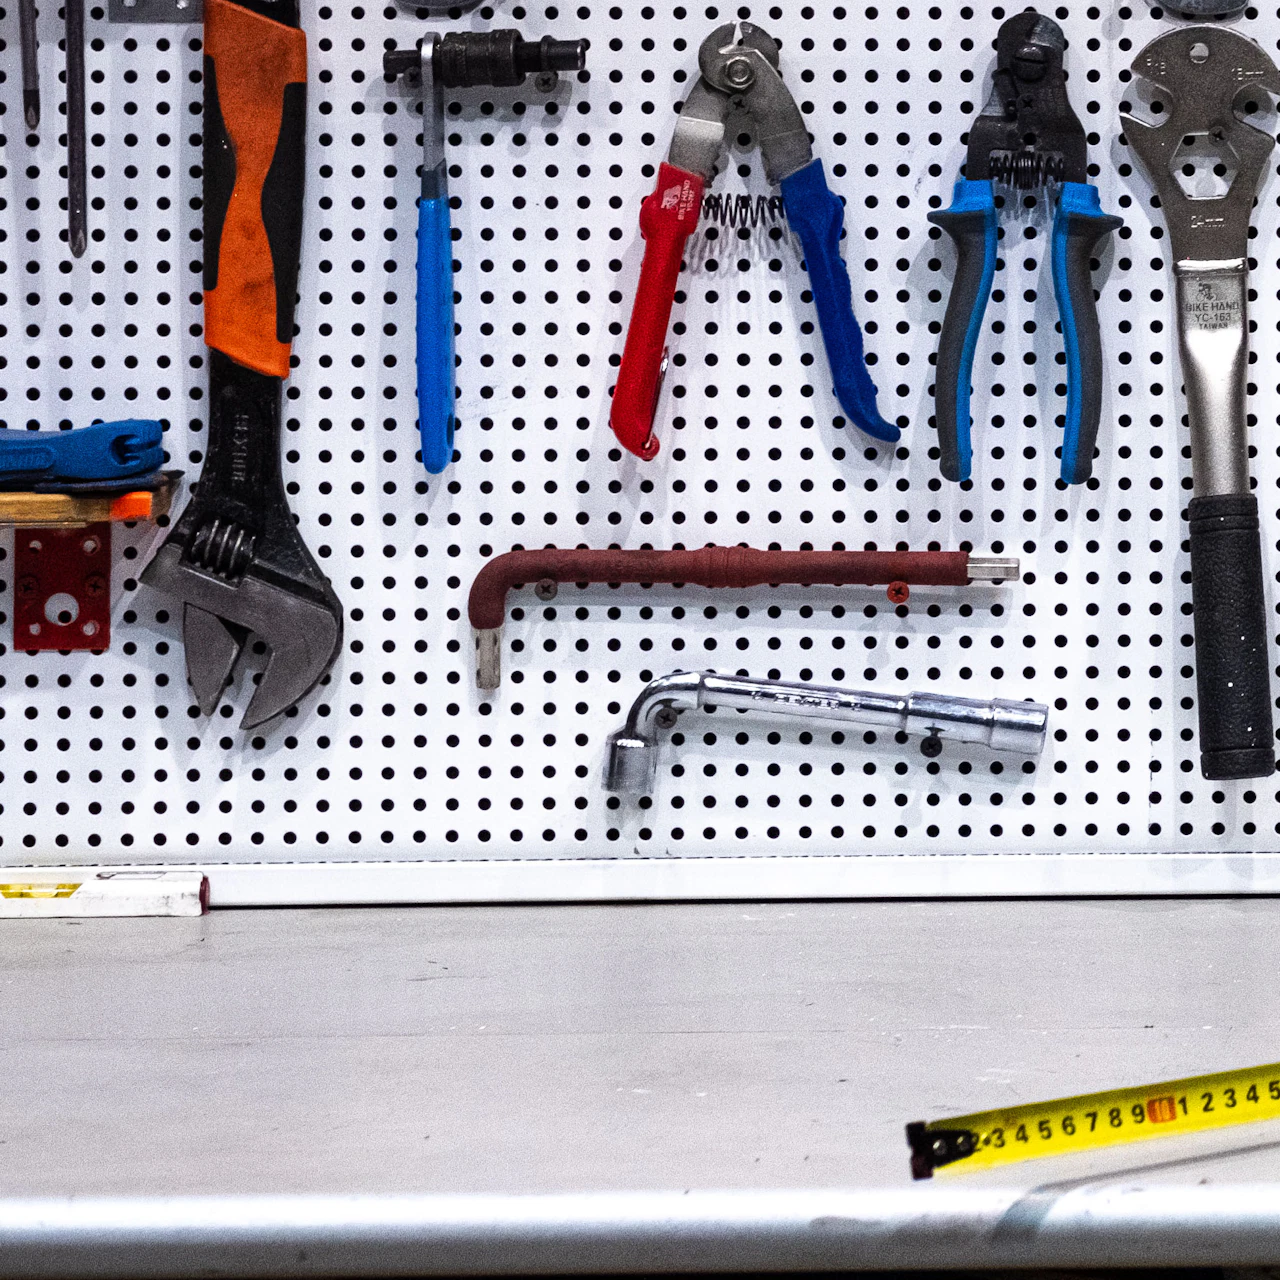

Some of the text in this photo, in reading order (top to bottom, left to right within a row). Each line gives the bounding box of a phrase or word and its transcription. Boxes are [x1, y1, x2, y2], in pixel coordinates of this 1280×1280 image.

[1185, 301, 1240, 312] BIKE HAND
[1194, 312, 1231, 322] YC-163
[992, 1127, 1006, 1148] 3
[1015, 1123, 1029, 1144] 4
[1037, 1119, 1053, 1140] 5
[1061, 1116, 1076, 1136] 6
[1085, 1112, 1098, 1132] 7
[1108, 1107, 1123, 1128] 8
[1131, 1103, 1146, 1124] 9
[1178, 1096, 1188, 1116] 1
[1202, 1092, 1216, 1113] 2
[1223, 1088, 1237, 1108] 3
[1246, 1084, 1260, 1104] 4
